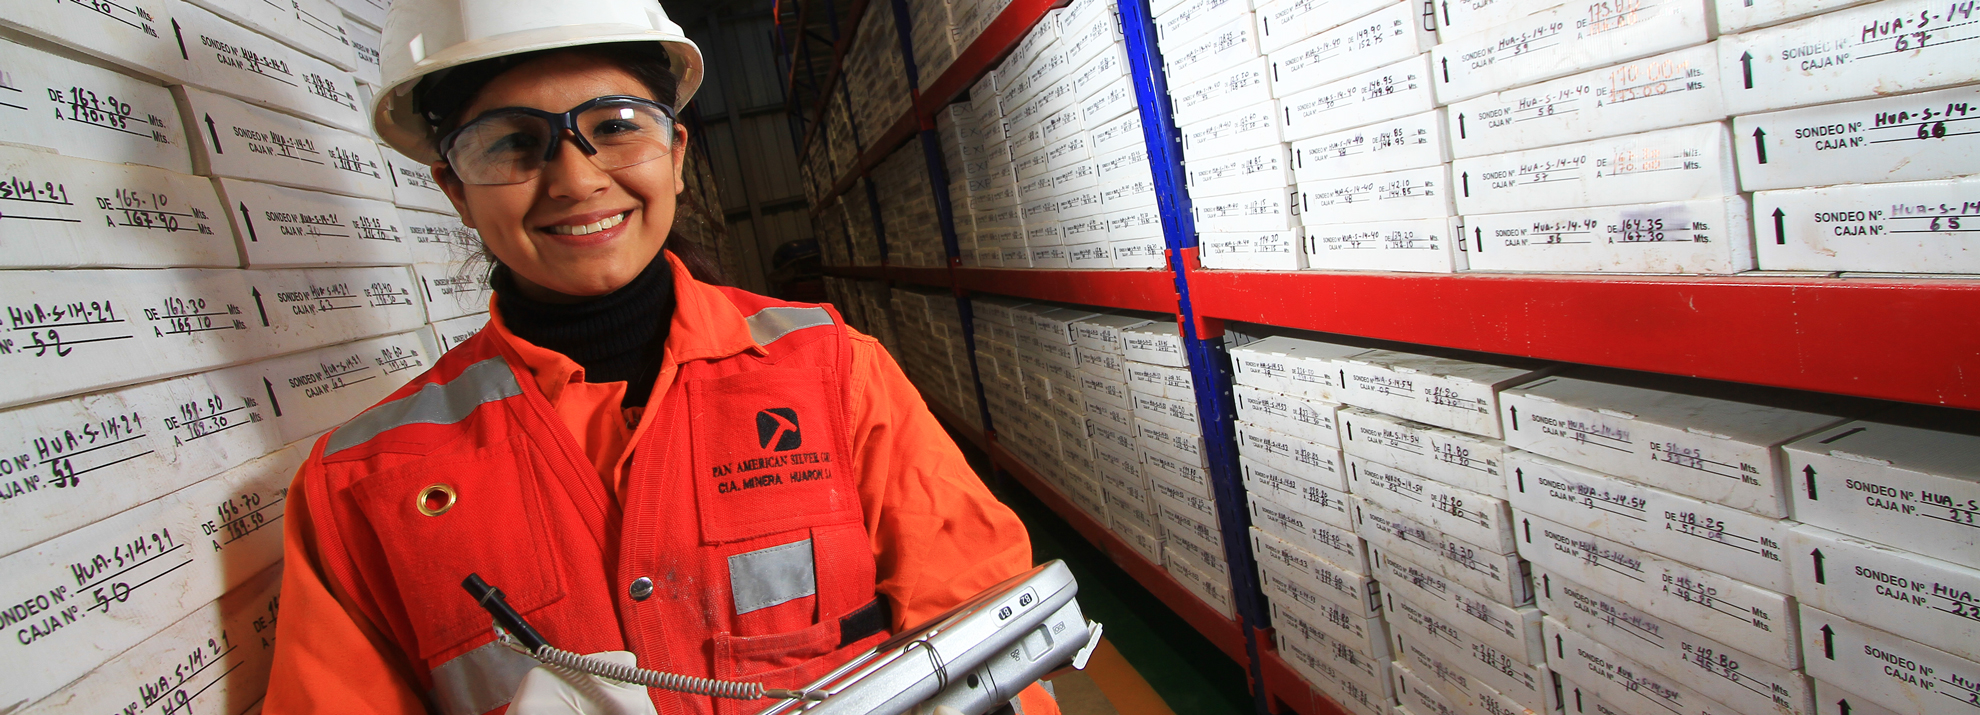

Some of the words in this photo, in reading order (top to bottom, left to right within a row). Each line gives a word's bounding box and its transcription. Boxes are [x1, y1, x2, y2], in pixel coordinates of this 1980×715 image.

[1356, 24, 1381, 40] 149.90
[1461, 49, 1487, 62] SONDEO
[1576, 18, 1587, 29] DE
[201, 35, 230, 53] SONDEO
[1471, 59, 1488, 70] CAJA
[1514, 42, 1529, 55] 59
[1577, 32, 1583, 40] A
[1801, 58, 1833, 70] CAJA
[1895, 31, 1931, 51] 67
[217, 53, 236, 67] CAJA
[1478, 109, 1503, 121] SONDEO
[1596, 88, 1607, 96] DE
[1686, 69, 1703, 78] Mts.
[48, 88, 64, 103] DE
[70, 87, 130, 116] 167.90
[148, 114, 166, 128] Mts.
[1489, 119, 1505, 129] CAJA
[1537, 105, 1554, 116] 58
[1596, 100, 1603, 108] A
[1687, 81, 1705, 91] Mts.
[56, 109, 63, 120] A
[152, 131, 170, 144] Mts.
[233, 127, 262, 142] SONDEO
[1795, 126, 1844, 138] SONDEO
[1816, 140, 1847, 150] CAJA
[1918, 121, 1946, 139] 66
[249, 143, 267, 155] CAJA
[1482, 171, 1507, 180] SONDEO
[1597, 158, 1607, 167] DE
[1492, 181, 1509, 189] CAJA
[1533, 173, 1548, 182] 57
[1597, 170, 1602, 178] A
[1684, 161, 1701, 169] Mts.
[97, 197, 114, 210] DE
[116, 188, 167, 209] 165.10
[193, 208, 209, 219] Mts.
[106, 215, 115, 227] A
[125, 210, 178, 232] 167.90
[198, 224, 214, 235] Mts.
[266, 211, 291, 223] SONDEO
[1814, 210, 1865, 222] SONDEO
[280, 226, 297, 236] CAJA
[1495, 229, 1520, 237] SONDEO
[1608, 224, 1617, 233] DE
[1622, 219, 1663, 231] 164.35
[1693, 222, 1710, 230] Mts.
[1835, 225, 1867, 235] CAJA
[1930, 217, 1960, 231] 65
[1547, 234, 1561, 243] 56
[1623, 231, 1664, 242] 167.30
[1694, 234, 1711, 243] Mts.
[277, 293, 304, 302] SONDEO
[144, 308, 160, 321] DE
[165, 297, 206, 315] 162.30
[228, 304, 242, 314] Mts.
[293, 305, 309, 315] CAJA
[154, 326, 163, 337] A
[233, 320, 247, 329] Mts.
[288, 374, 316, 388] SONDEO
[306, 387, 323, 398] CAJA
[165, 417, 179, 430] DE
[181, 395, 222, 421] 159.50
[1532, 414, 1558, 427] SONDEO
[1542, 426, 1559, 436] CAJA
[174, 436, 183, 447] A
[712, 463, 732, 477] PAN
[737, 455, 788, 473] AMERICAN
[791, 453, 819, 465] SILVER
[743, 474, 783, 490] MINERA
[790, 469, 823, 483] HUARON
[1846, 479, 1896, 498] SONDEO
[1539, 478, 1566, 491] SONDEO
[1679, 511, 1725, 533] 48.25
[1550, 490, 1567, 501] CAJA
[1584, 497, 1594, 509] 13
[202, 521, 218, 535] DE
[217, 493, 260, 522] 156.70
[1866, 496, 1898, 513] CAJA
[1950, 509, 1974, 523] 23
[1544, 530, 1571, 545] SONDEO
[1555, 542, 1571, 554] CAJA
[18, 617, 63, 645] CAJA
[93, 582, 130, 613] 50
[213, 540, 222, 551] A
[227, 513, 264, 541] 159.50
[1855, 566, 1908, 589] SONDEO
[1020, 593, 1032, 607] B2
[1564, 587, 1590, 605] SONDEO
[1875, 585, 1908, 603] CAJA
[1952, 603, 1980, 618] 22
[999, 606, 1012, 620] B1
[1574, 601, 1591, 615] CAJA
[1577, 648, 1604, 668] SONDEO
[1864, 645, 1915, 672] SONDEO
[1588, 662, 1605, 677] CAJA
[1625, 681, 1639, 692] 10
[1884, 666, 1917, 684] CAJA
